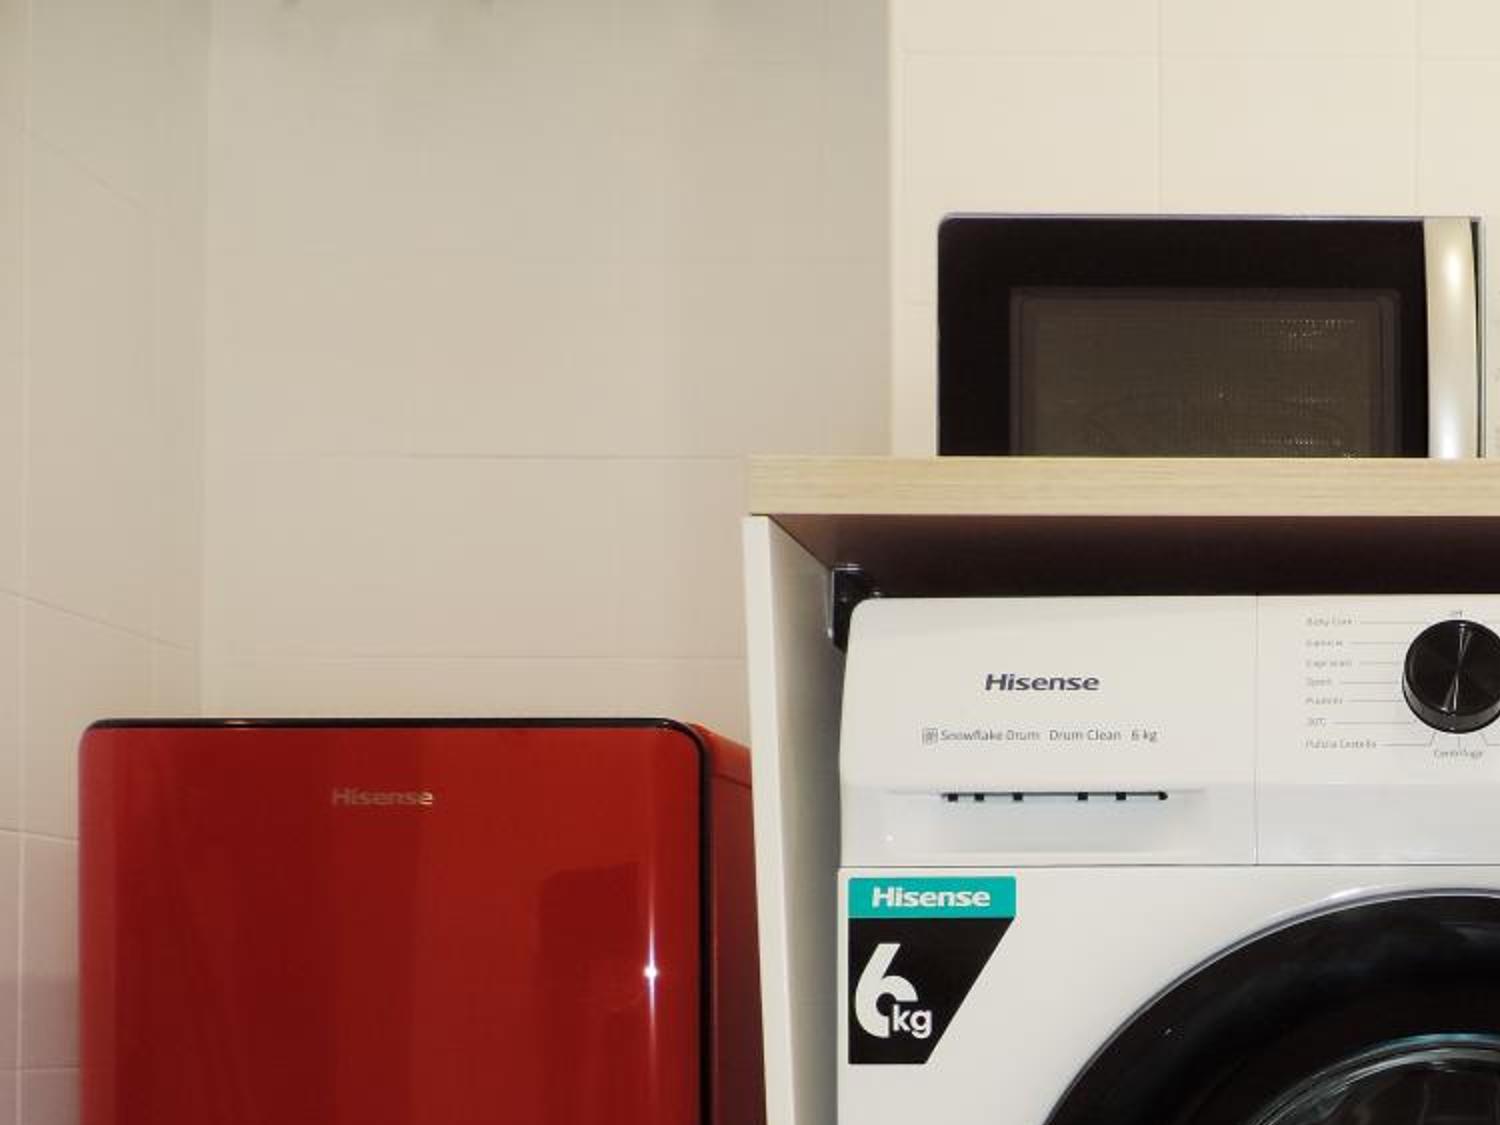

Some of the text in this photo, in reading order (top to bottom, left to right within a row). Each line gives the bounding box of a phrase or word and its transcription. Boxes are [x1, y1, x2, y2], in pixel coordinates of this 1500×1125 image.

[985, 672, 1101, 692] Hisense
[940, 729, 1158, 744] Snowflake Drum Drum Clean 6 kg
[332, 786, 434, 806] Hisense
[872, 886, 991, 908] Hisense
